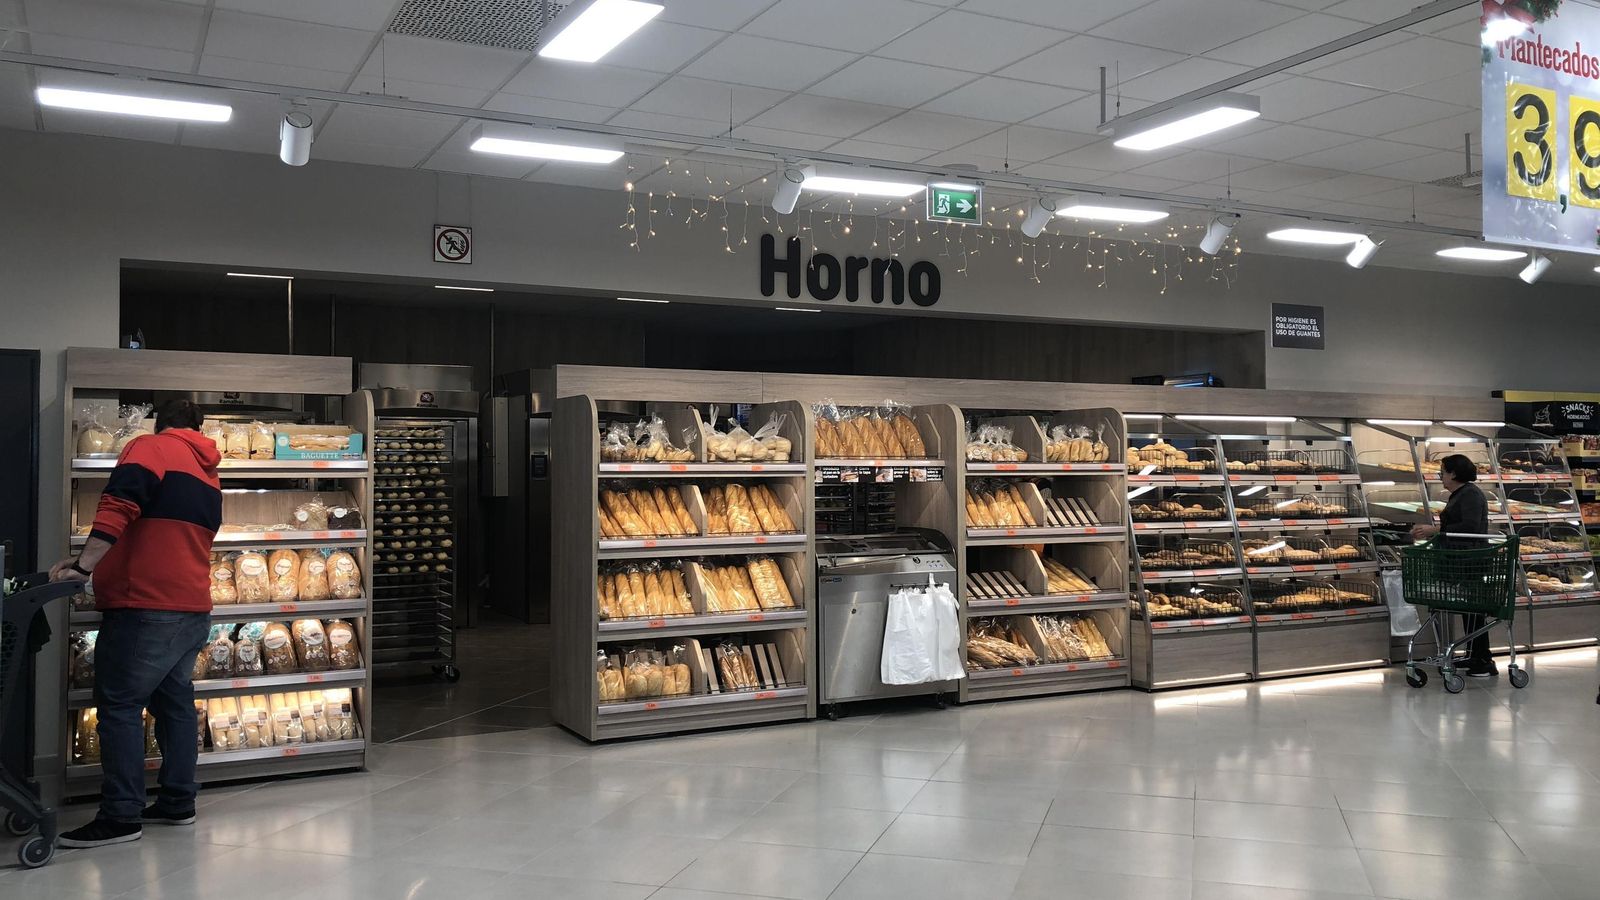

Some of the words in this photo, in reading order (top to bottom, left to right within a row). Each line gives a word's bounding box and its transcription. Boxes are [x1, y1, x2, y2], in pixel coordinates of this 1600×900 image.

[1496, 33, 1600, 80] Mantecados
[761, 233, 941, 307] Horno
[1275, 322, 1311, 331] OBLIGATORIO
[1296, 330, 1321, 338] GUANTES
[1565, 402, 1590, 415] SNACKS
